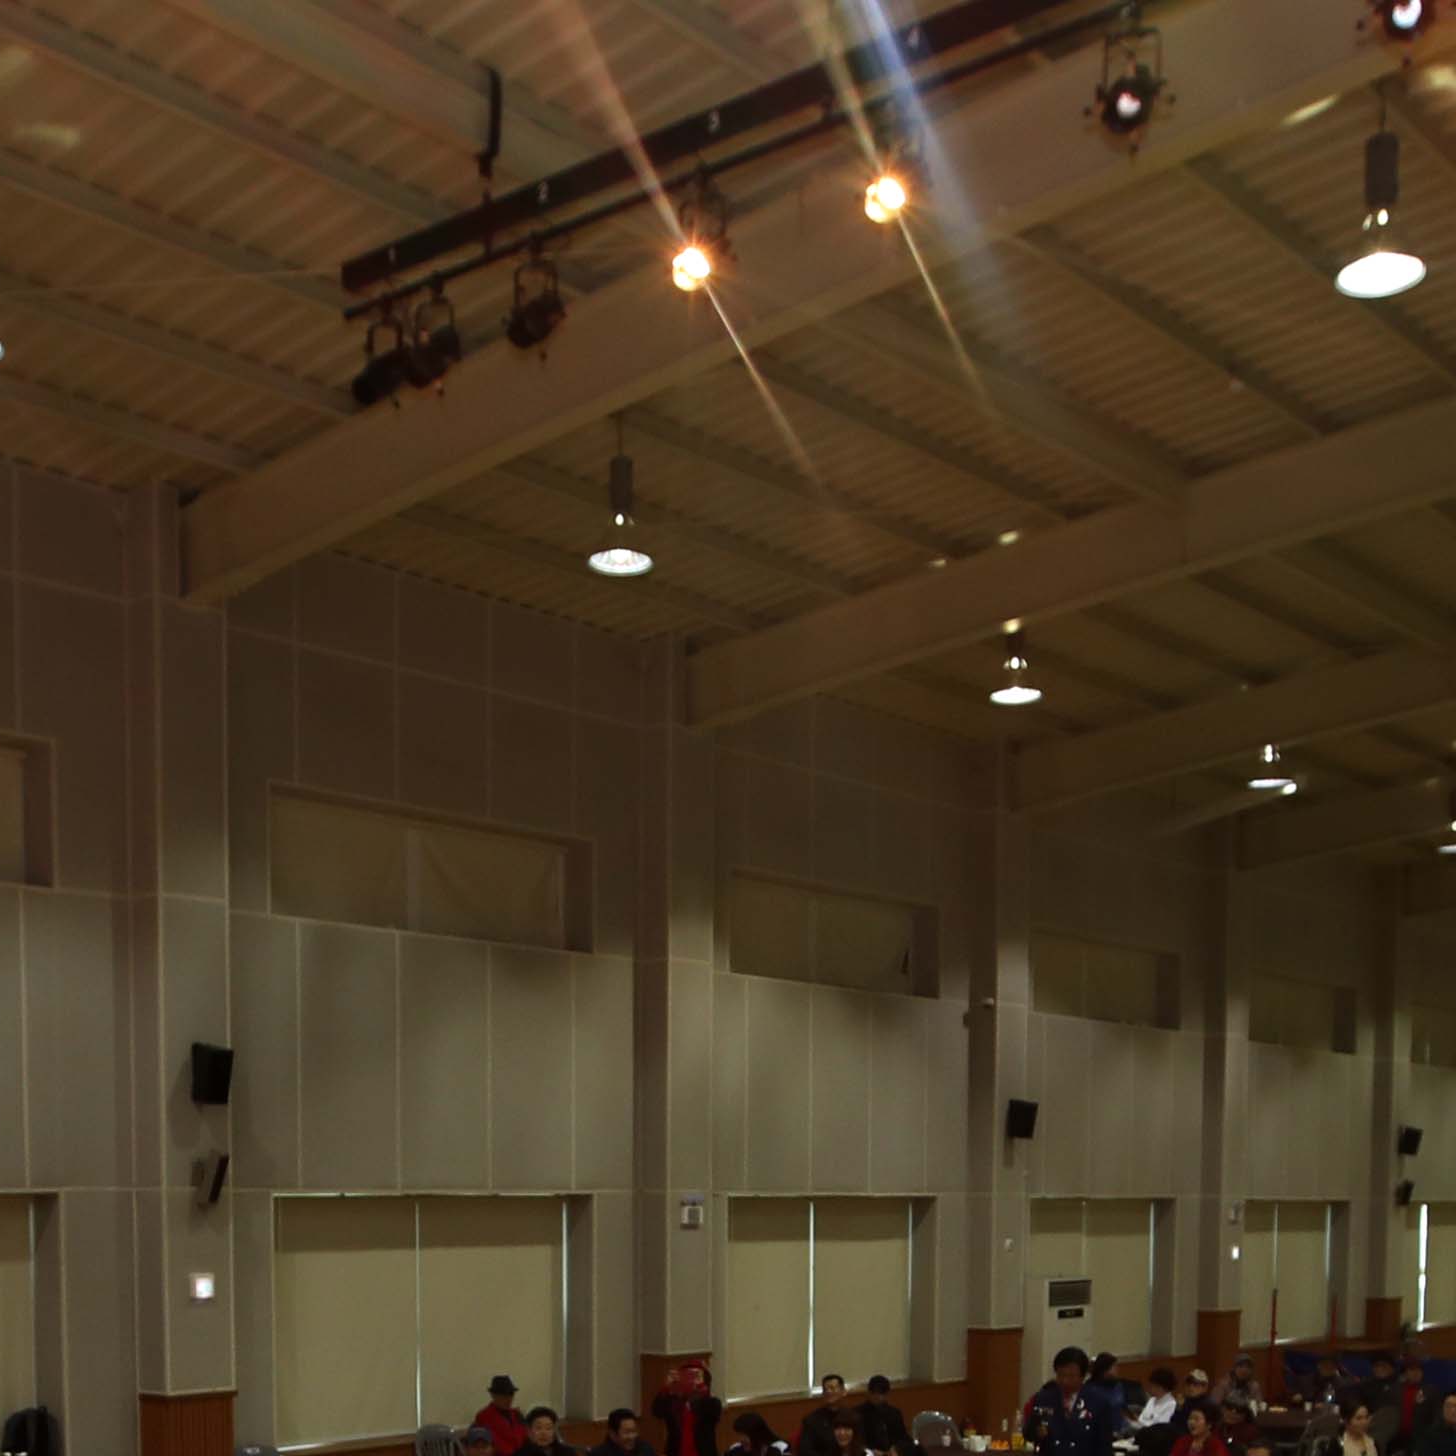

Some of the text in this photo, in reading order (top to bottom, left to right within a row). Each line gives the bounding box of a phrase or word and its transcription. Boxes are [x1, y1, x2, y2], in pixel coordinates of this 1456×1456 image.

[537, 181, 550, 203] 2
[708, 110, 721, 133] 3
[906, 25, 921, 49] 4
